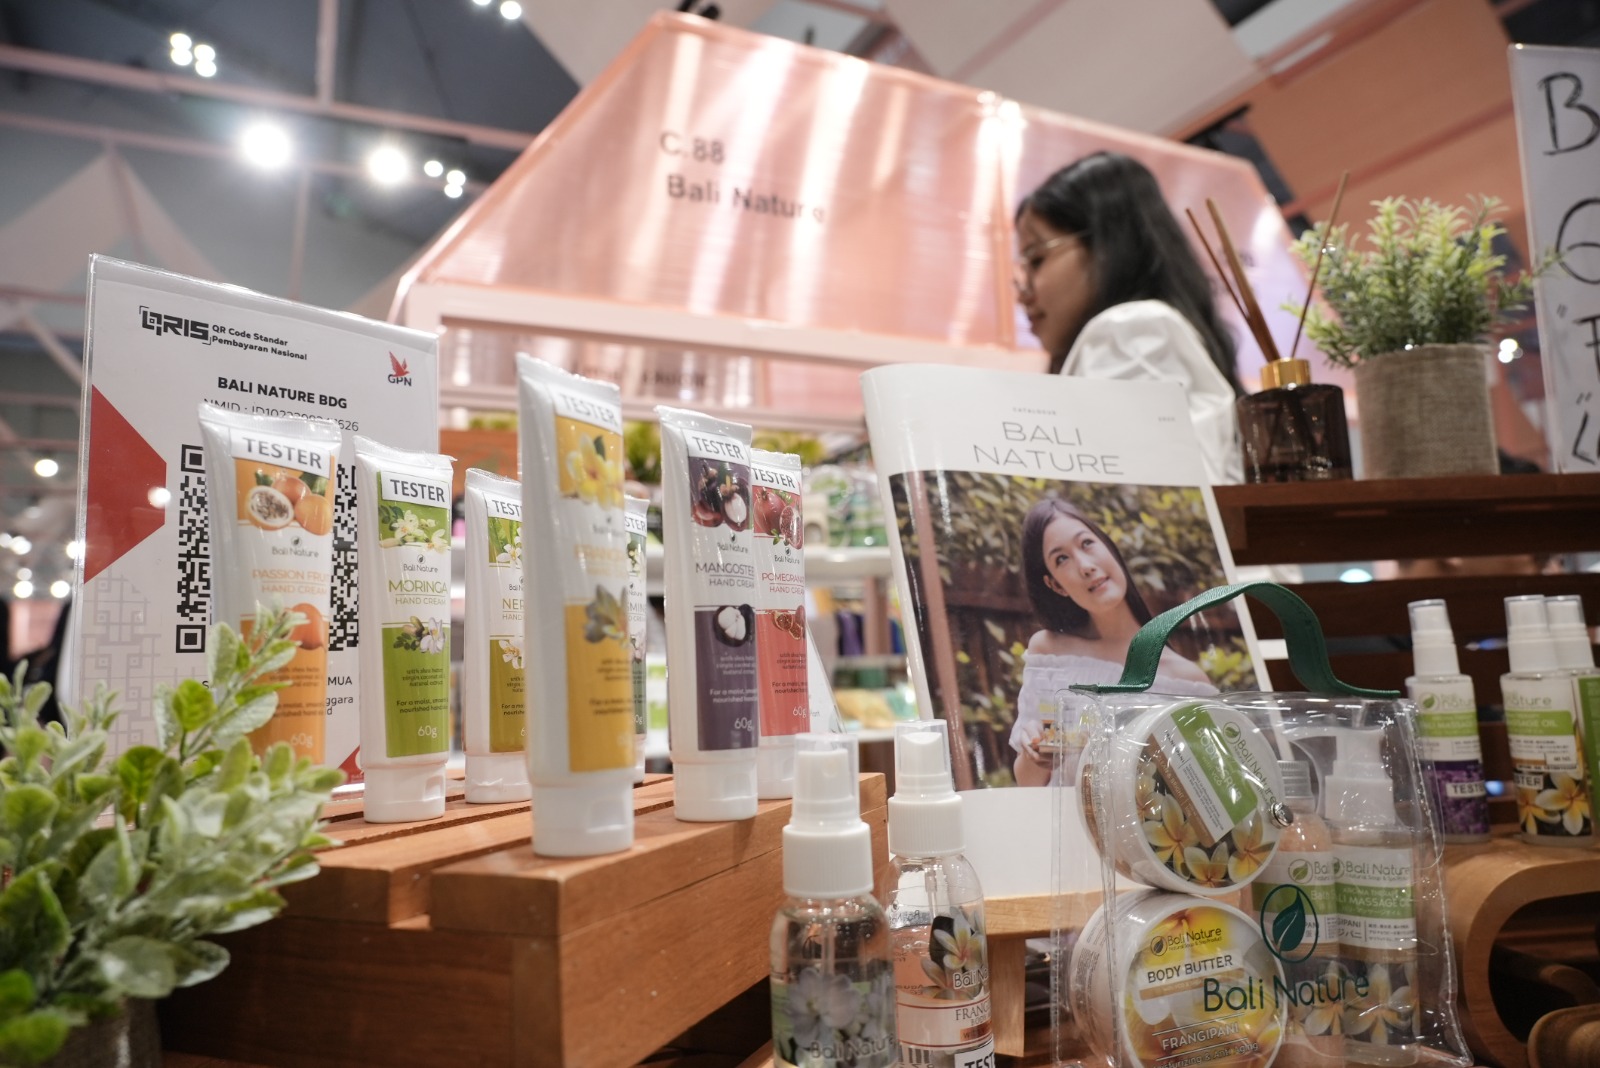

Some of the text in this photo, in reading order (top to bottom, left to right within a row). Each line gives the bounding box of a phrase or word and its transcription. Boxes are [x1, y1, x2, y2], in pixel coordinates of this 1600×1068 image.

[659, 131, 725, 164] C.88
[668, 173, 825, 223] Bali Nature
[141, 308, 210, 342] QRIS
[212, 324, 288, 347] QR Code Standar
[212, 335, 307, 360] Pembayaran Nasional
[387, 374, 412, 387] GPN
[218, 376, 347, 409] BALI NATURE BDG
[559, 394, 618, 428] TESTER
[1002, 421, 1082, 446] BALI
[243, 437, 322, 469] TESTER
[692, 436, 744, 460] TESTER
[973, 445, 1124, 475] NATURE
[752, 467, 796, 489] TESTER
[390, 479, 445, 503] TESTER
[492, 499, 522, 517] TEST
[624, 517, 646, 531] STER
[272, 546, 319, 558] Bali Nature
[730, 544, 748, 553] Nature
[774, 554, 783, 563] Bali
[252, 568, 304, 580] PASSION
[403, 563, 439, 573] Bali Nature
[262, 585, 295, 593] HAND
[388, 579, 448, 594] MORINGA
[709, 578, 735, 587] HAND
[769, 586, 790, 594] HAND
[395, 597, 421, 605] HAND
[327, 675, 353, 686] MUA
[792, 706, 806, 718] 60g
[417, 725, 437, 738] 60g
[734, 717, 753, 732] 60g
[291, 732, 314, 749] 60g
[1193, 726, 1220, 761] BODY
[1235, 739, 1256, 762] Bali
[1514, 775, 1542, 786] STER
[1346, 861, 1369, 874] Bali
[1349, 896, 1398, 909] MASSAGE
[1167, 928, 1222, 946] Bali Nature
[1148, 965, 1181, 983] BODY
[1185, 955, 1233, 976] BUTTER
[953, 969, 978, 990] Bali
[1203, 976, 1265, 1012] Bali
[1273, 974, 1370, 1010] Nature
[1161, 1022, 1240, 1051] FRANGIPANI
[810, 1041, 844, 1060] Bali
